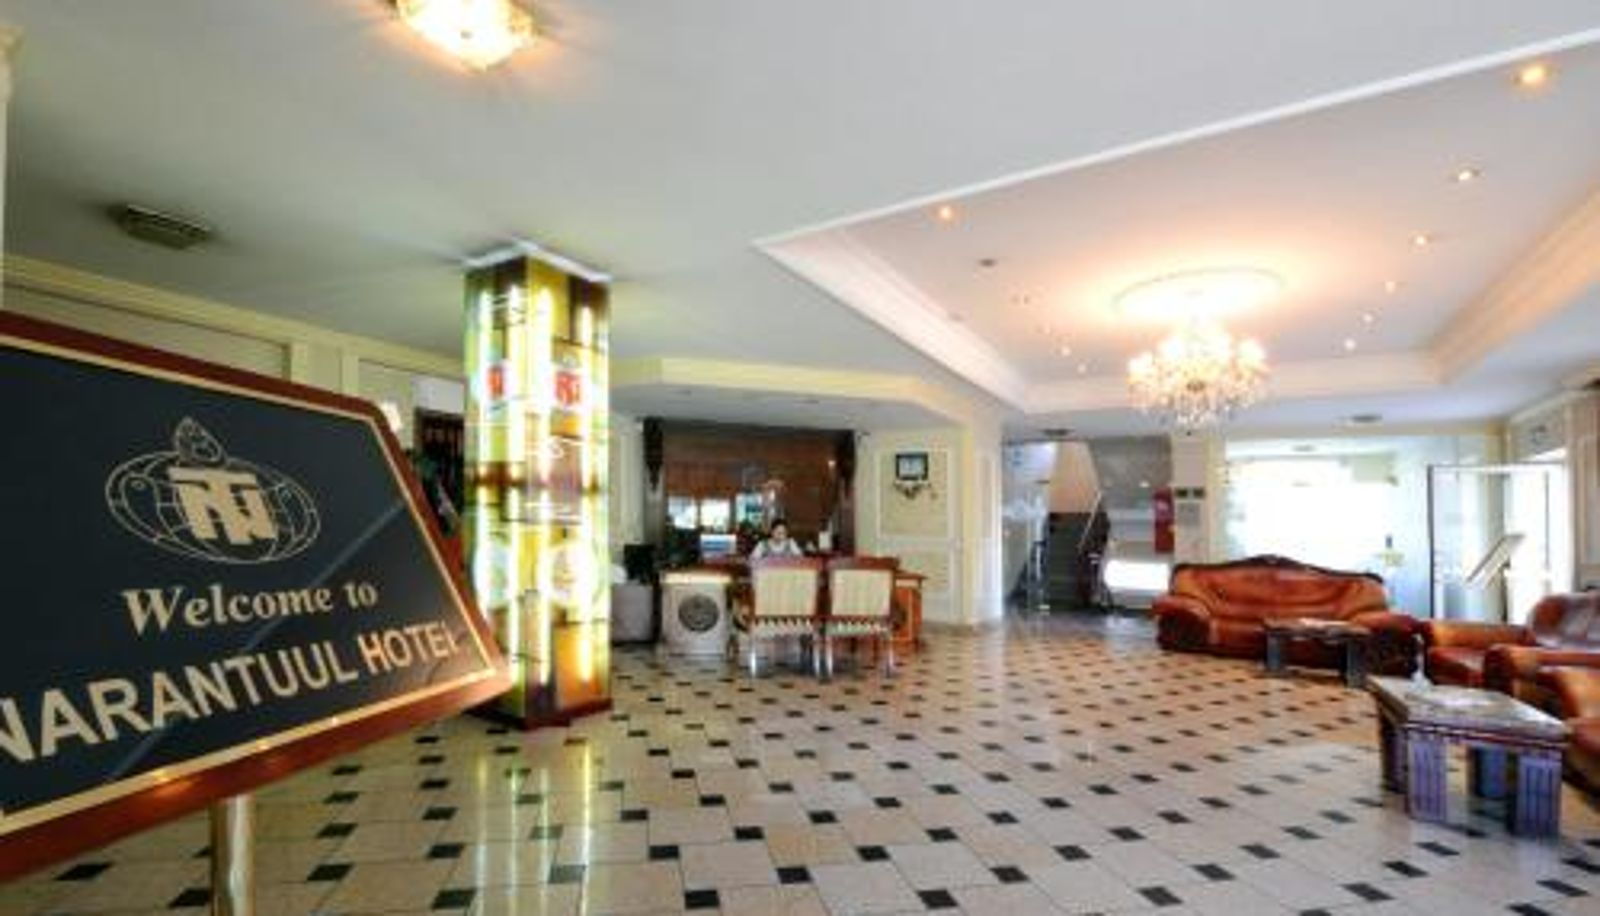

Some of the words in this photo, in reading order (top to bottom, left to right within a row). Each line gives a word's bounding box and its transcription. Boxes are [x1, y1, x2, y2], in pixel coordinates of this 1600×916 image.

[121, 582, 334, 636] Welcome
[343, 582, 379, 609] to
[0, 641, 359, 762] NARANTUUL
[357, 620, 459, 676] HOTEL
